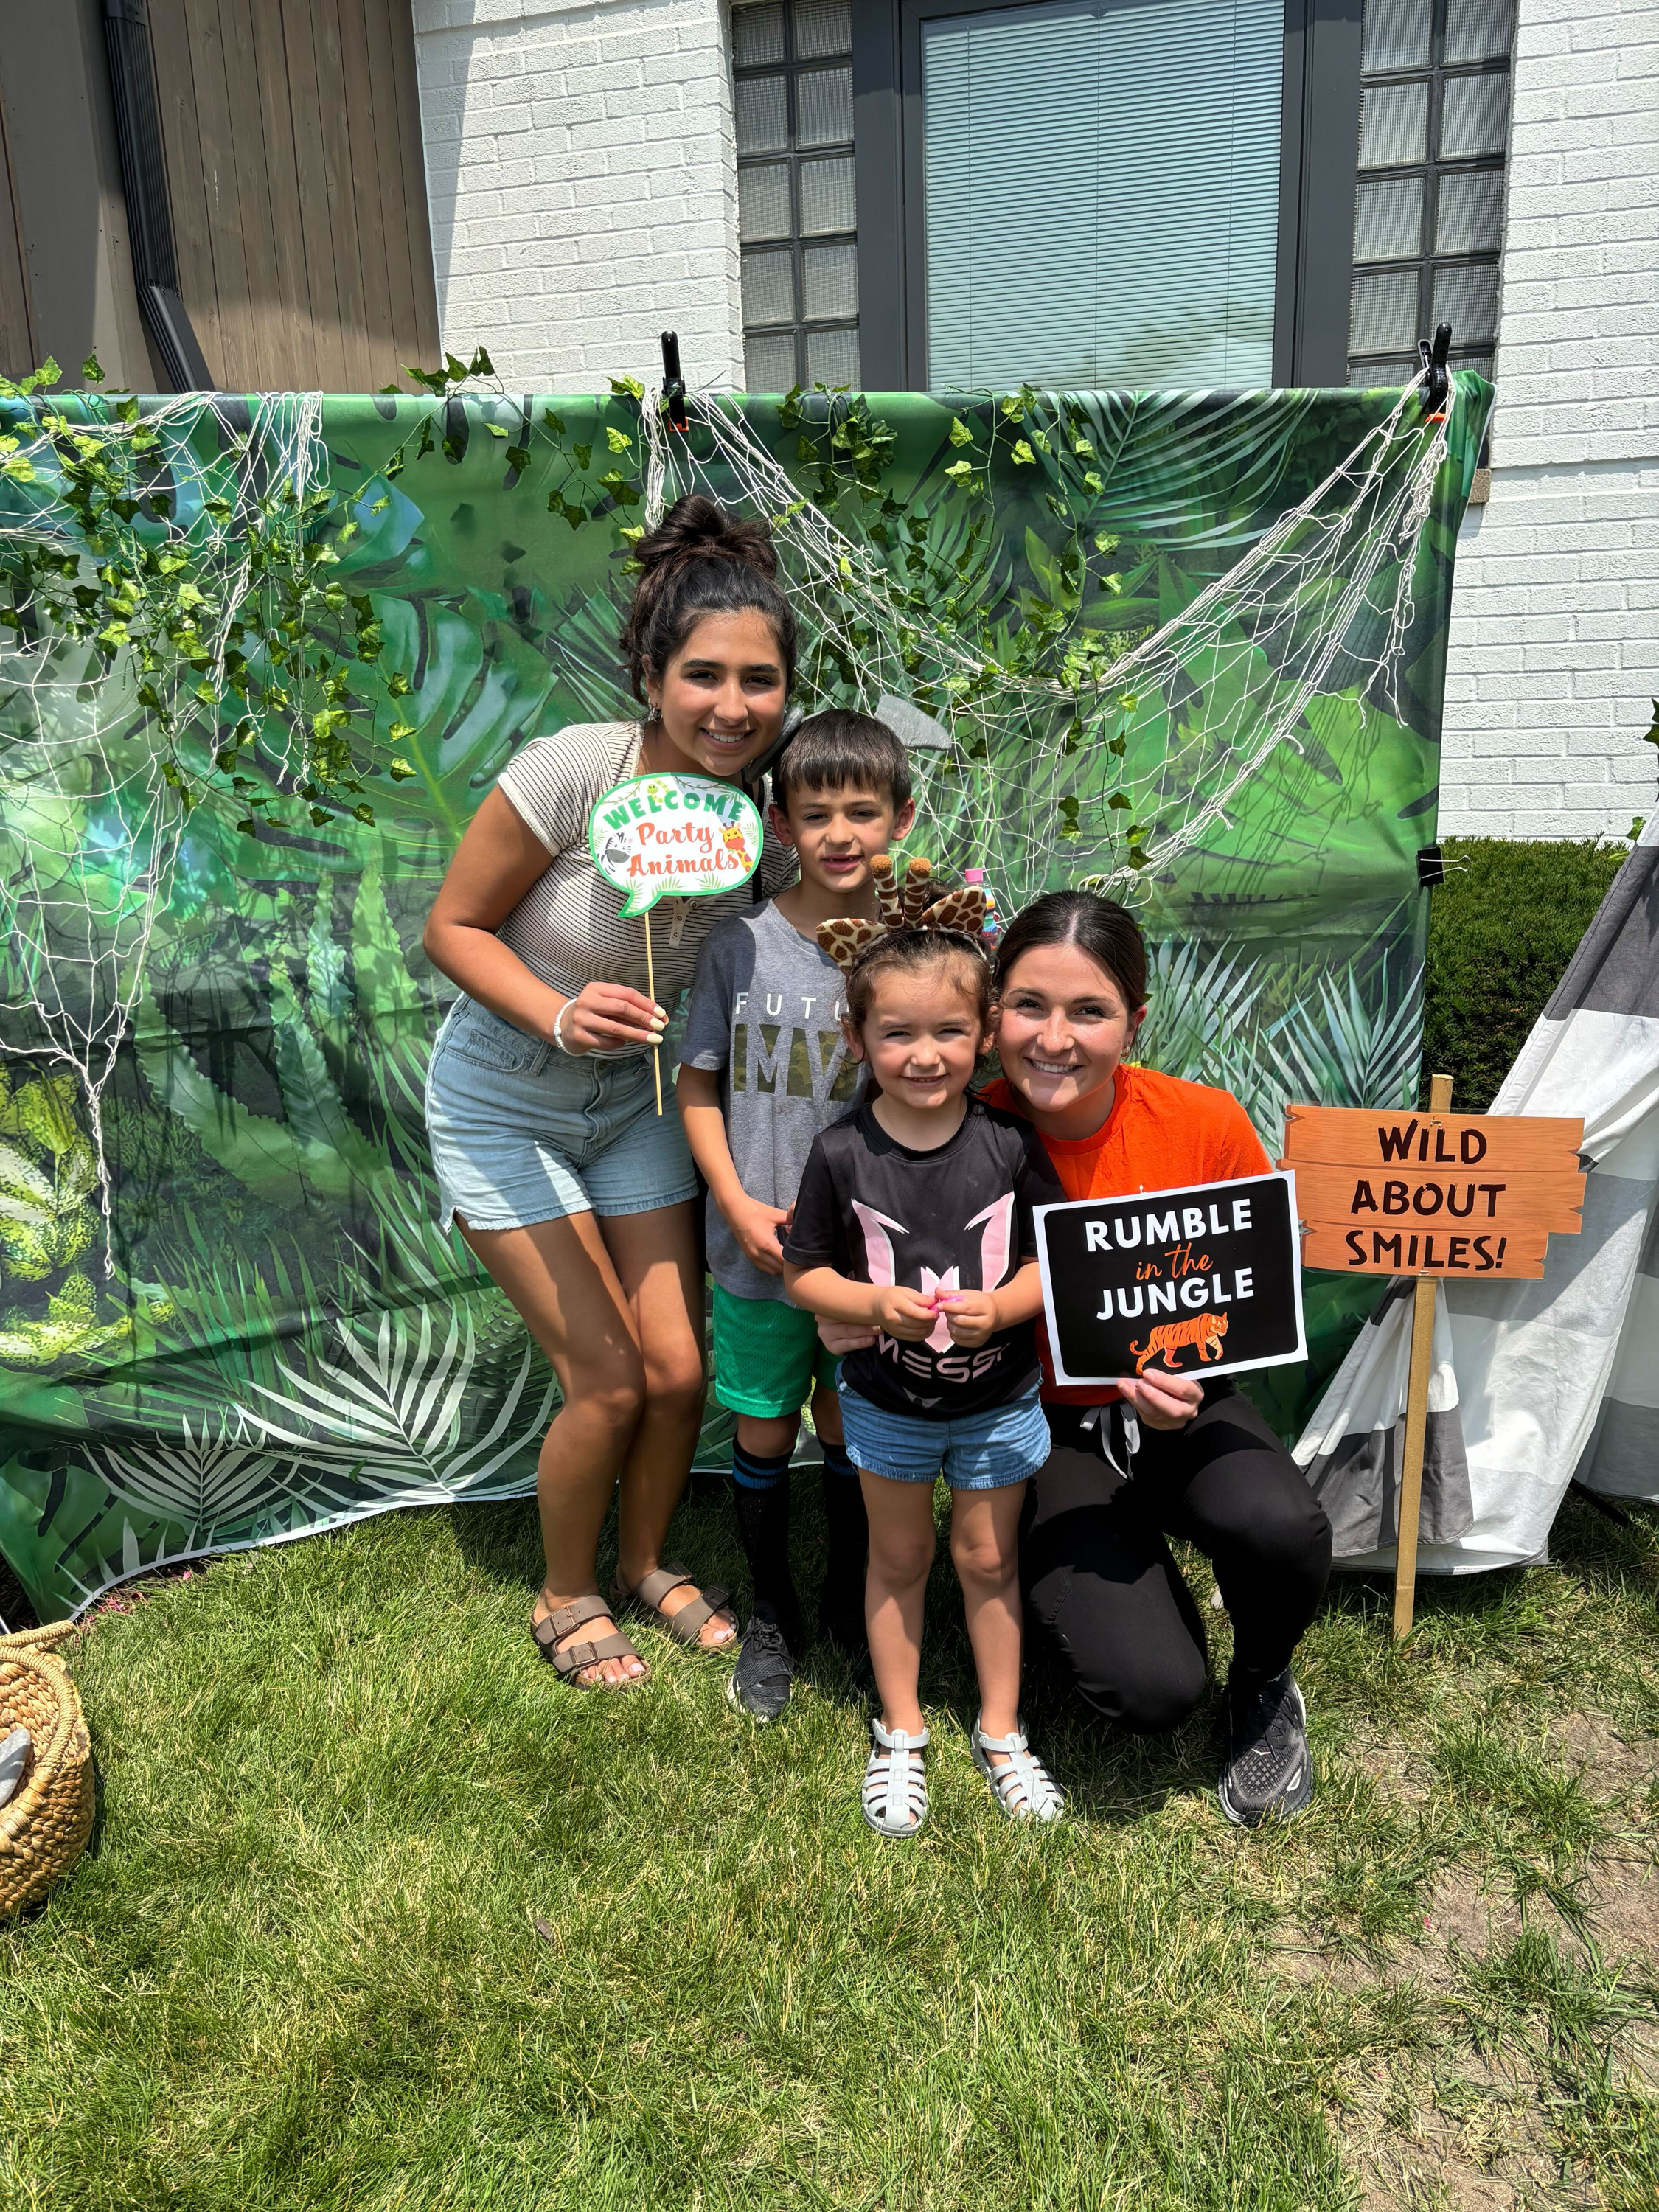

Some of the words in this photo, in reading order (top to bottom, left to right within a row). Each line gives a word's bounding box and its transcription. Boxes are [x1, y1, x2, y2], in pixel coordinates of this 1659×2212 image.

[602, 790, 747, 831] WELCOME
[636, 822, 714, 854] Party
[627, 848, 739, 877] Animals
[1377, 1118, 1487, 1164] WILD
[1351, 1180, 1506, 1217] ABOUT
[1085, 1198, 1253, 1252] RUMBLE
[1135, 1262, 1163, 1281] in
[1164, 1242, 1214, 1279] the
[1345, 1230, 1507, 1271] SMILES!
[1096, 1267, 1254, 1321] JUNGLE
